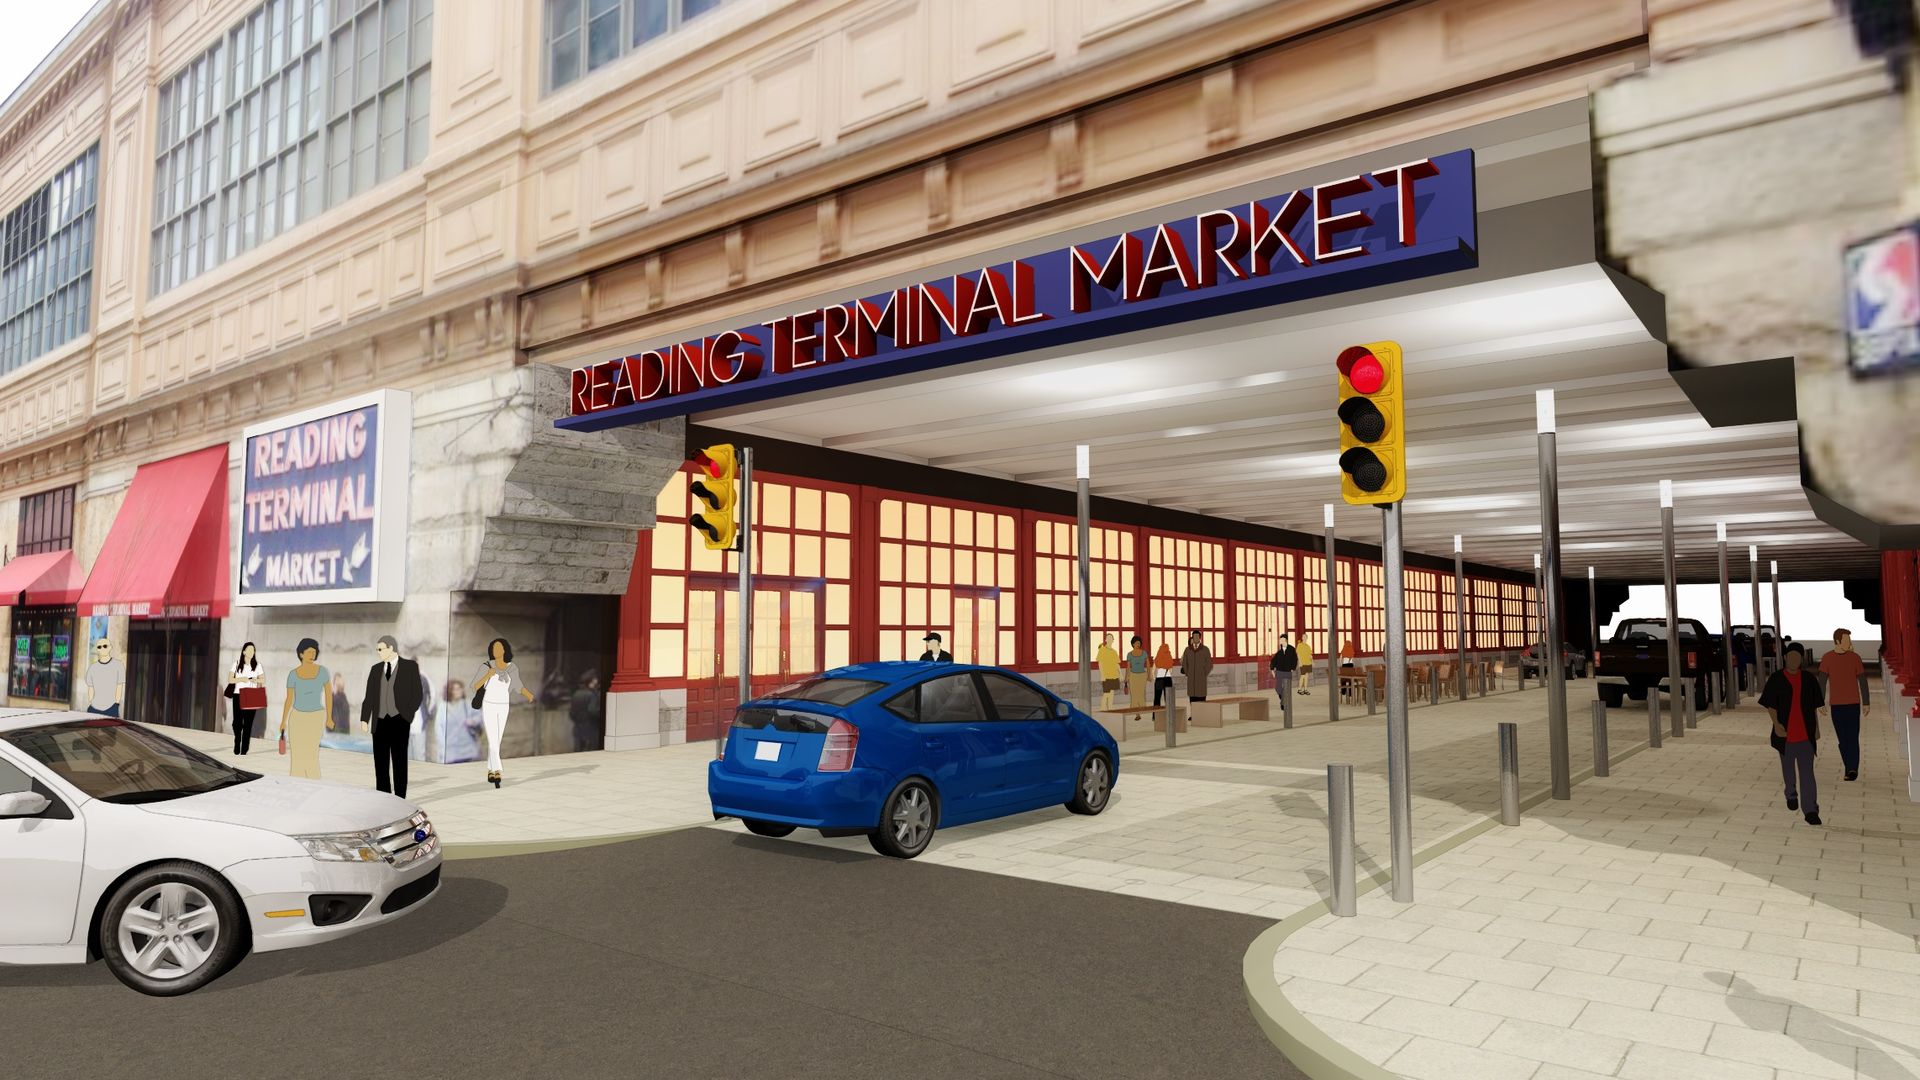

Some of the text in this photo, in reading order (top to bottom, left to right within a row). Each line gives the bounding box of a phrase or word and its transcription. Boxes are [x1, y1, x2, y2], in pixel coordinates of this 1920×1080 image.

[570, 158, 1432, 416] READING TERMINAL MARKET
[254, 411, 367, 479] READING
[245, 473, 375, 534] TERMINAL
[265, 549, 342, 588] MARKET
